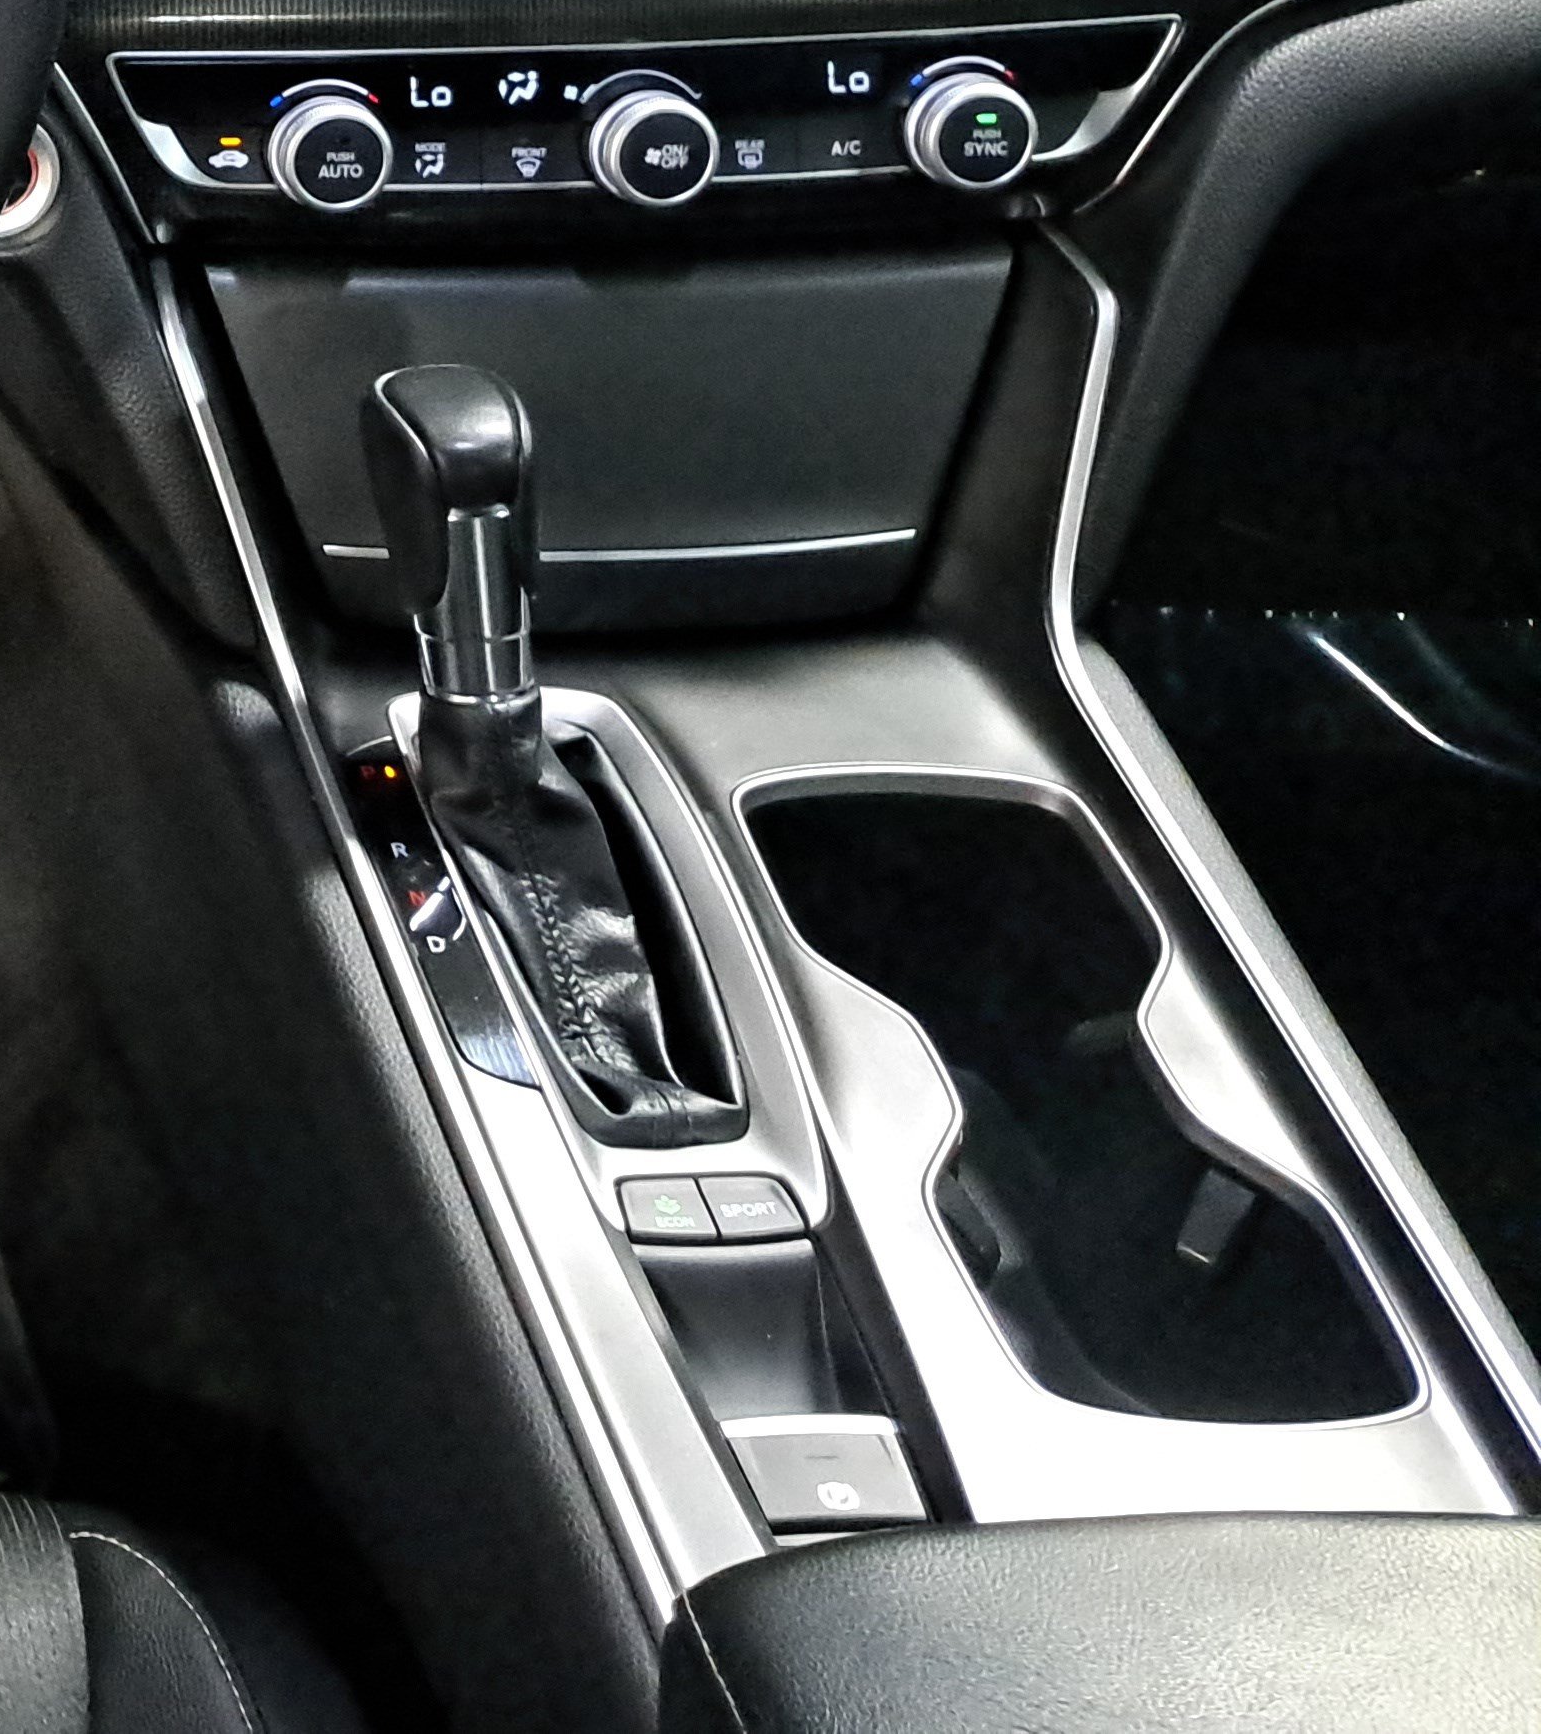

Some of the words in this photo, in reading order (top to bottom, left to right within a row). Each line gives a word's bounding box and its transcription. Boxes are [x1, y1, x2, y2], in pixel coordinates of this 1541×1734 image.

[735, 139, 765, 150] REAR
[831, 140, 861, 156] A/C
[963, 140, 1009, 158] SYNC
[326, 152, 355, 162] PUSH
[318, 164, 363, 178] AUTO
[390, 842, 410, 859] R
[426, 935, 446, 953] D
[720, 1200, 777, 1218] SPORT
